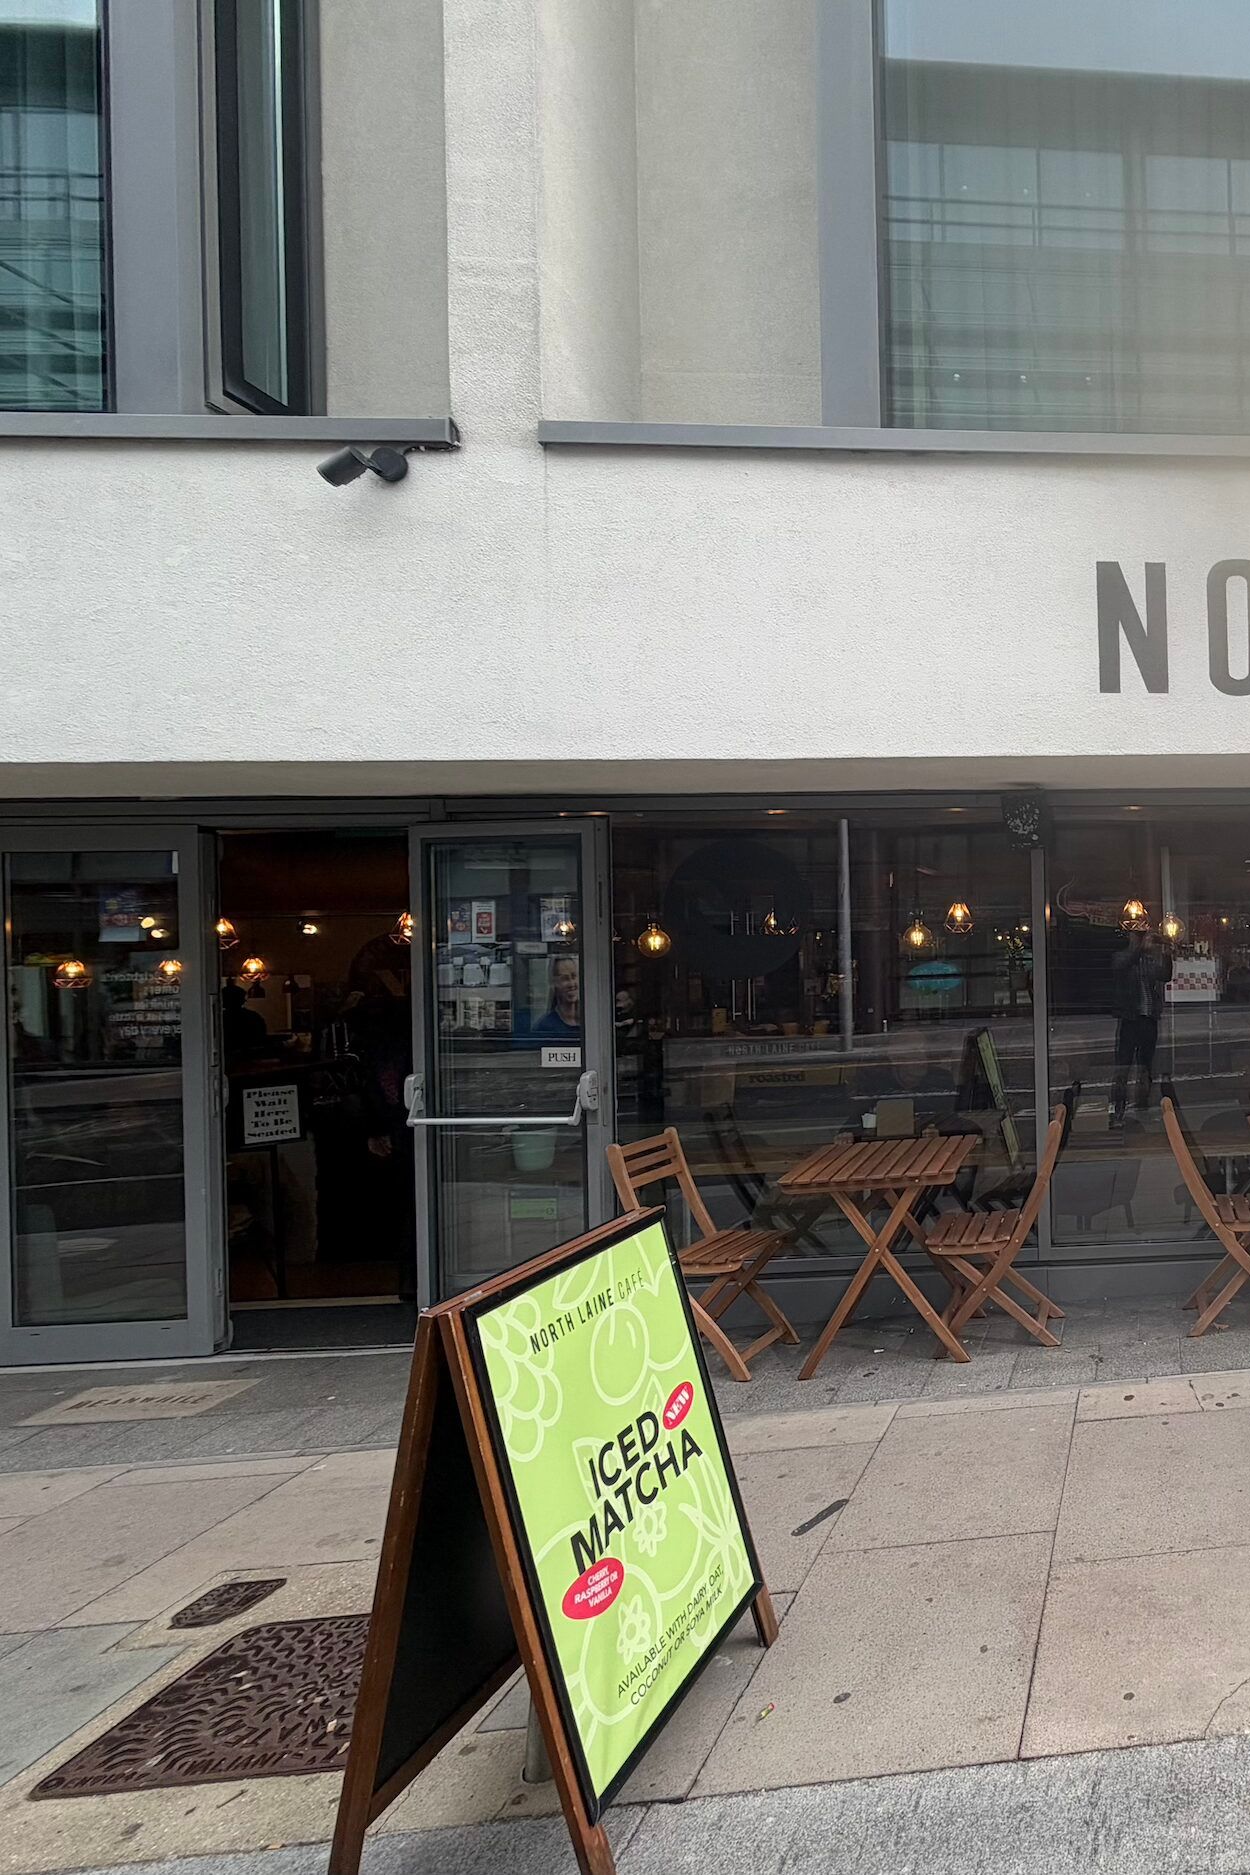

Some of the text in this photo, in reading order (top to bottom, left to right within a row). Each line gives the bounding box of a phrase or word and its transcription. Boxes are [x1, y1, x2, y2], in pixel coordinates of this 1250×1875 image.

[548, 1052, 576, 1062] PUSH
[246, 1090, 295, 1099] Please
[254, 1098, 288, 1107] Wait
[250, 1118, 292, 1128] To Be
[254, 1110, 289, 1118] Here
[530, 1267, 645, 1354] NORTH LAINE CAFÉ
[63, 1393, 213, 1411] MEANWHILE
[666, 1384, 691, 1426] NEW
[588, 1411, 660, 1500] ICED
[570, 1428, 703, 1576] MATCHA
[574, 1571, 618, 1604] RASPBERRY OR
[587, 1587, 612, 1608] VANILLA
[618, 1636, 667, 1698] AVAILABLE
[666, 1610, 687, 1639] WITH
[630, 1584, 722, 1705] COCONUT OR SOYA MILK
[183, 1750, 292, 1776] VALIANT
